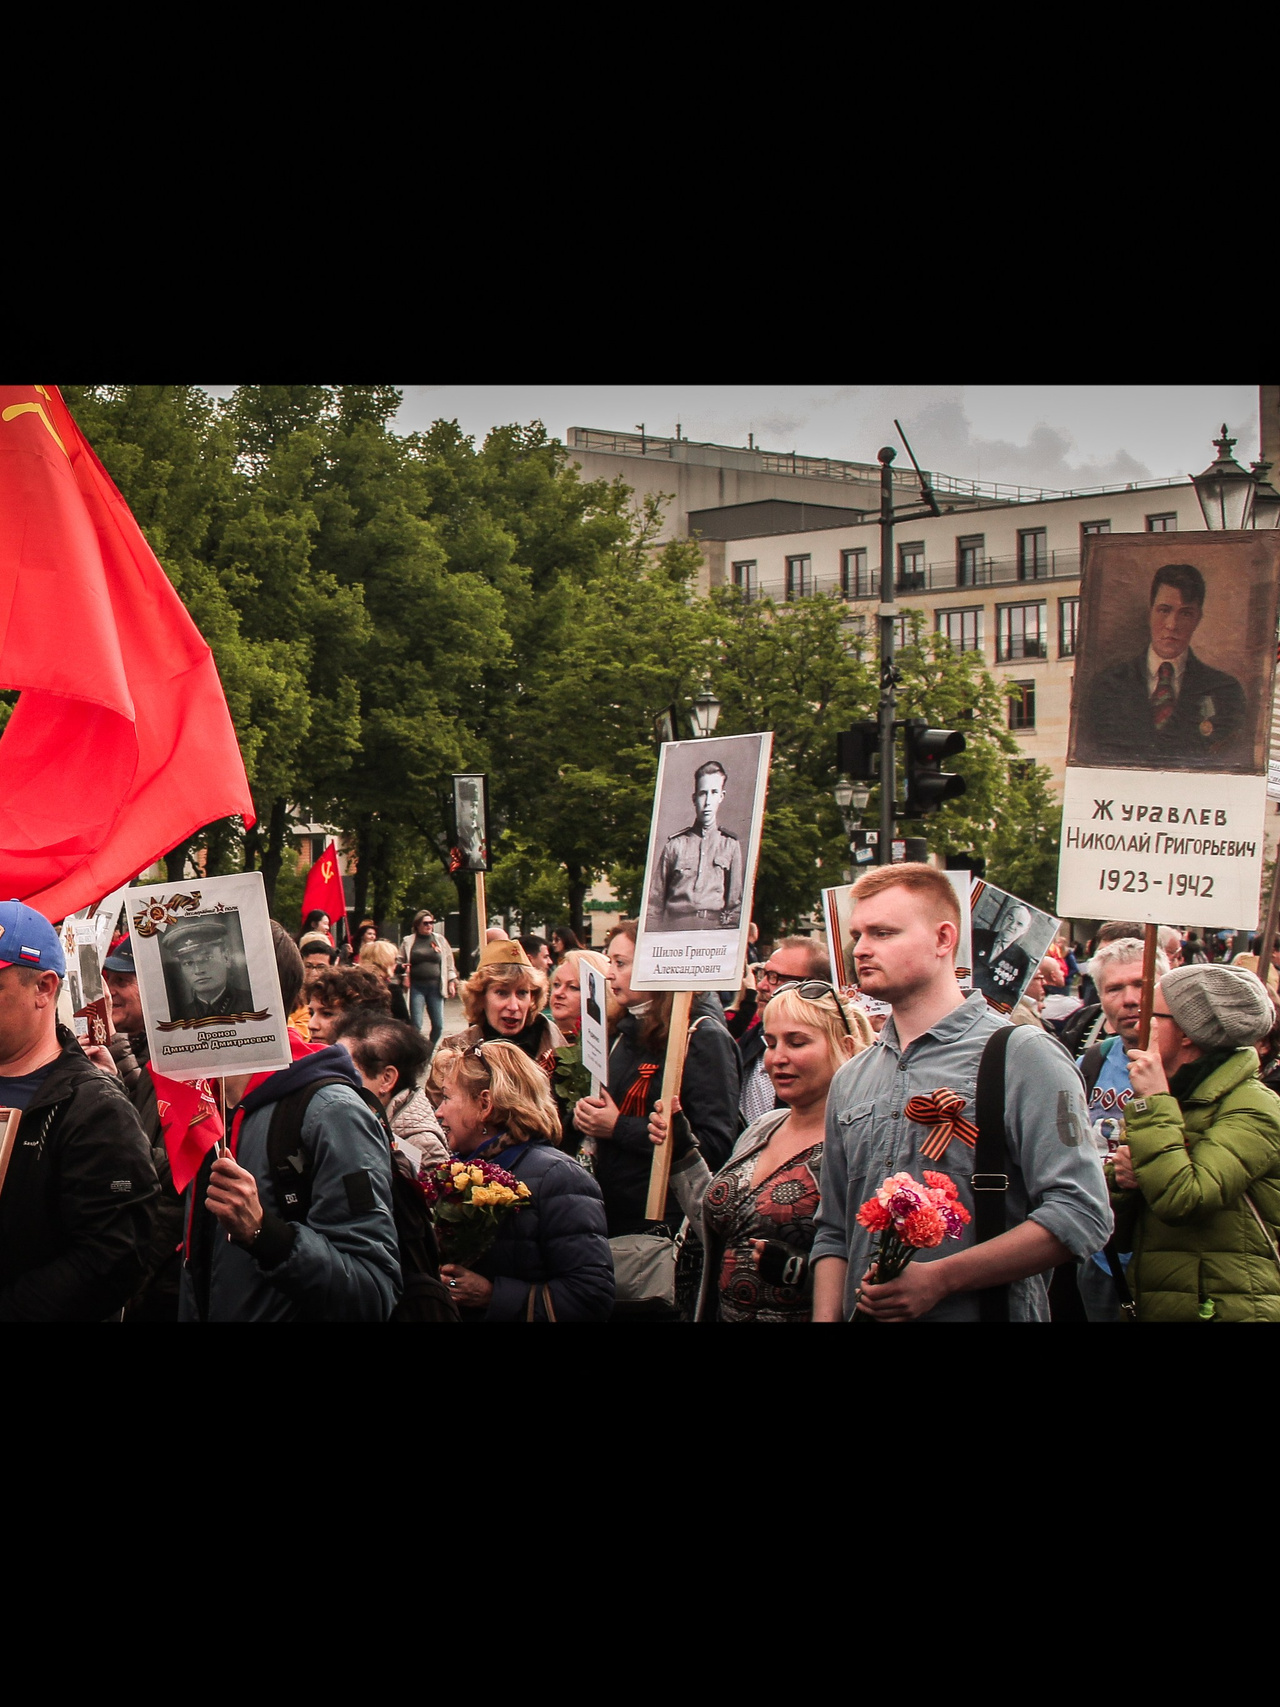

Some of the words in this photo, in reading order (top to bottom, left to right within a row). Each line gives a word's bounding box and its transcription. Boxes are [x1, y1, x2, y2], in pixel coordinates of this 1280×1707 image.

[652, 946, 683, 958] Шилов
[685, 945, 727, 959] Григорий
[653, 964, 721, 976] Александрович
[197, 1029, 237, 1041] Дронов
[162, 1042, 209, 1055] Дмитрий
[211, 1035, 276, 1050] Дмитриевич
[1088, 1086, 1135, 1112] РОС
